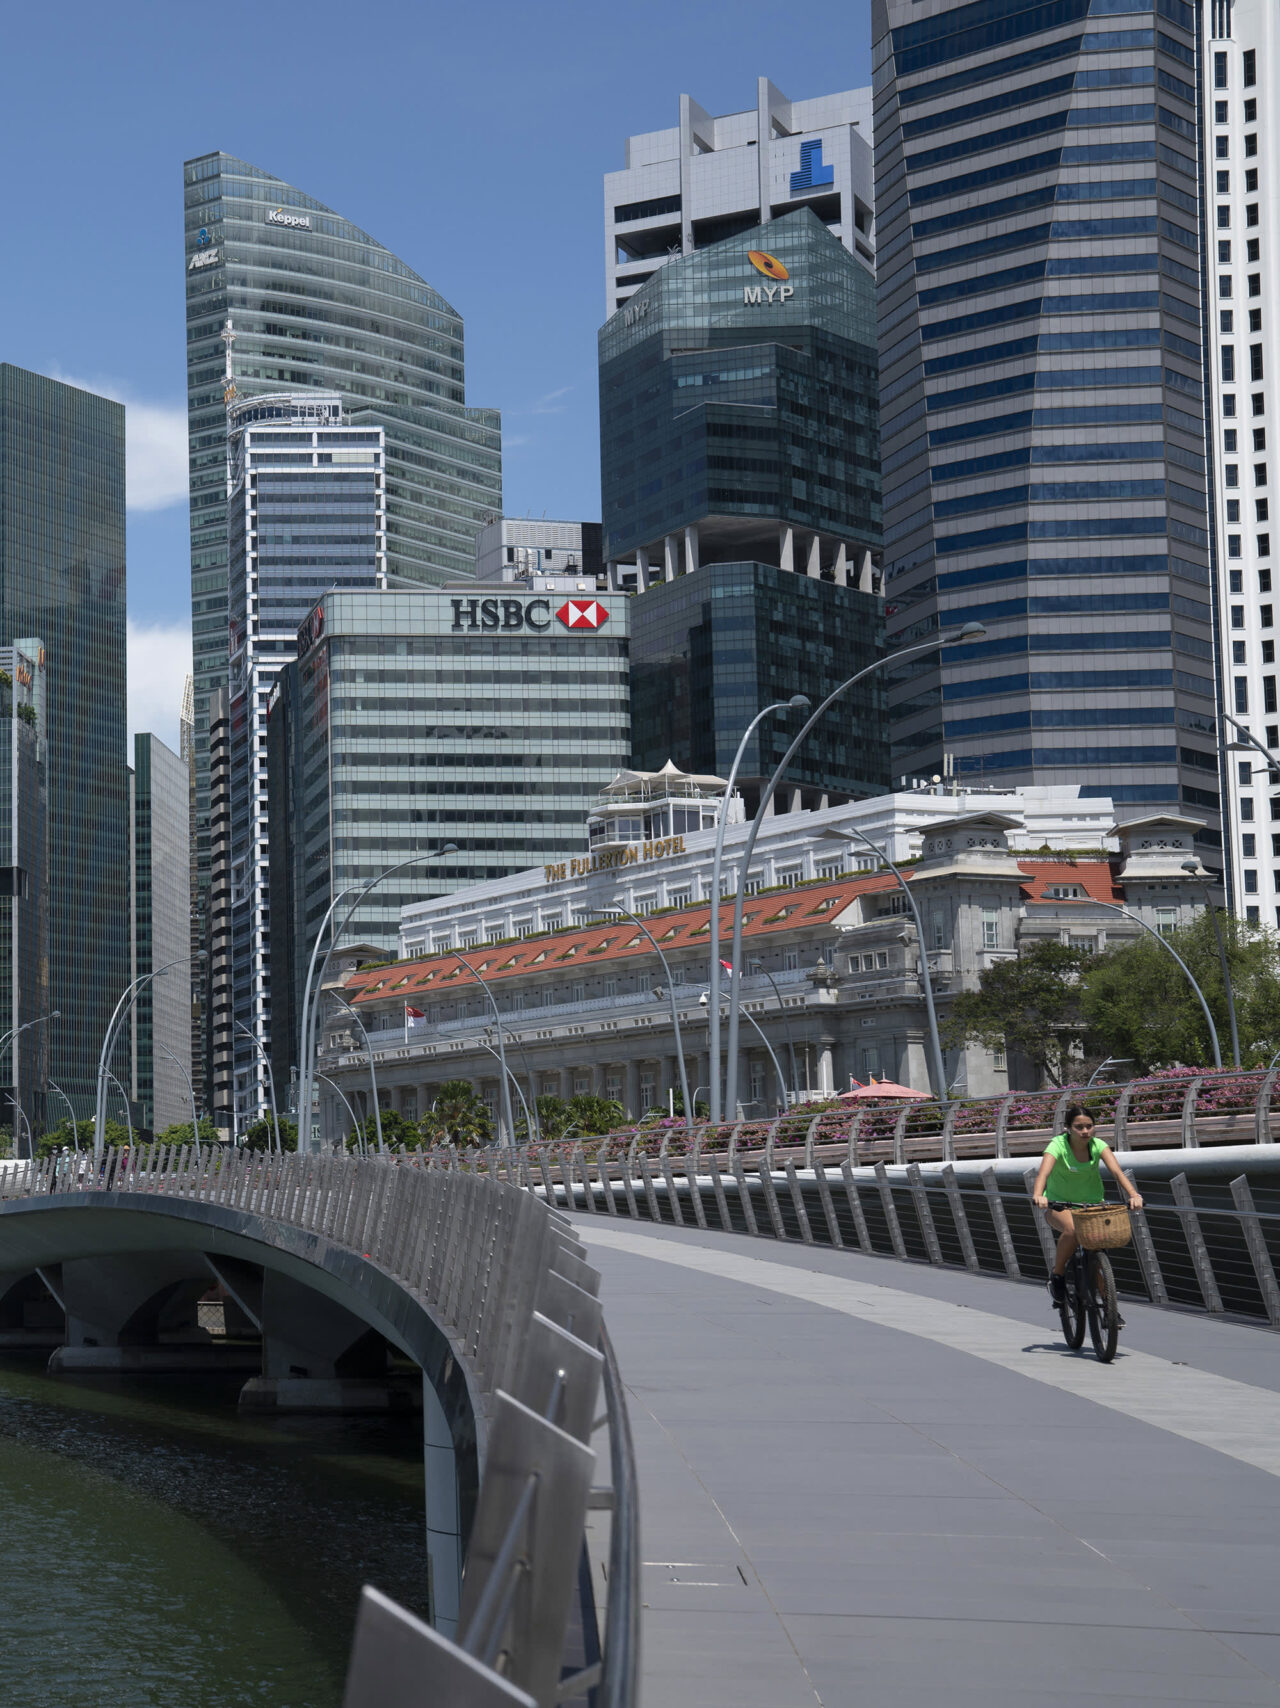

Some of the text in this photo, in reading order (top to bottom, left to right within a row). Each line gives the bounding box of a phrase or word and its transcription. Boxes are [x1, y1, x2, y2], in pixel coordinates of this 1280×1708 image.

[269, 209, 310, 227] Keppel
[743, 285, 794, 304] MYP
[451, 598, 551, 629] HSBC
[544, 835, 686, 882] THE FULLERTON HOTEL
